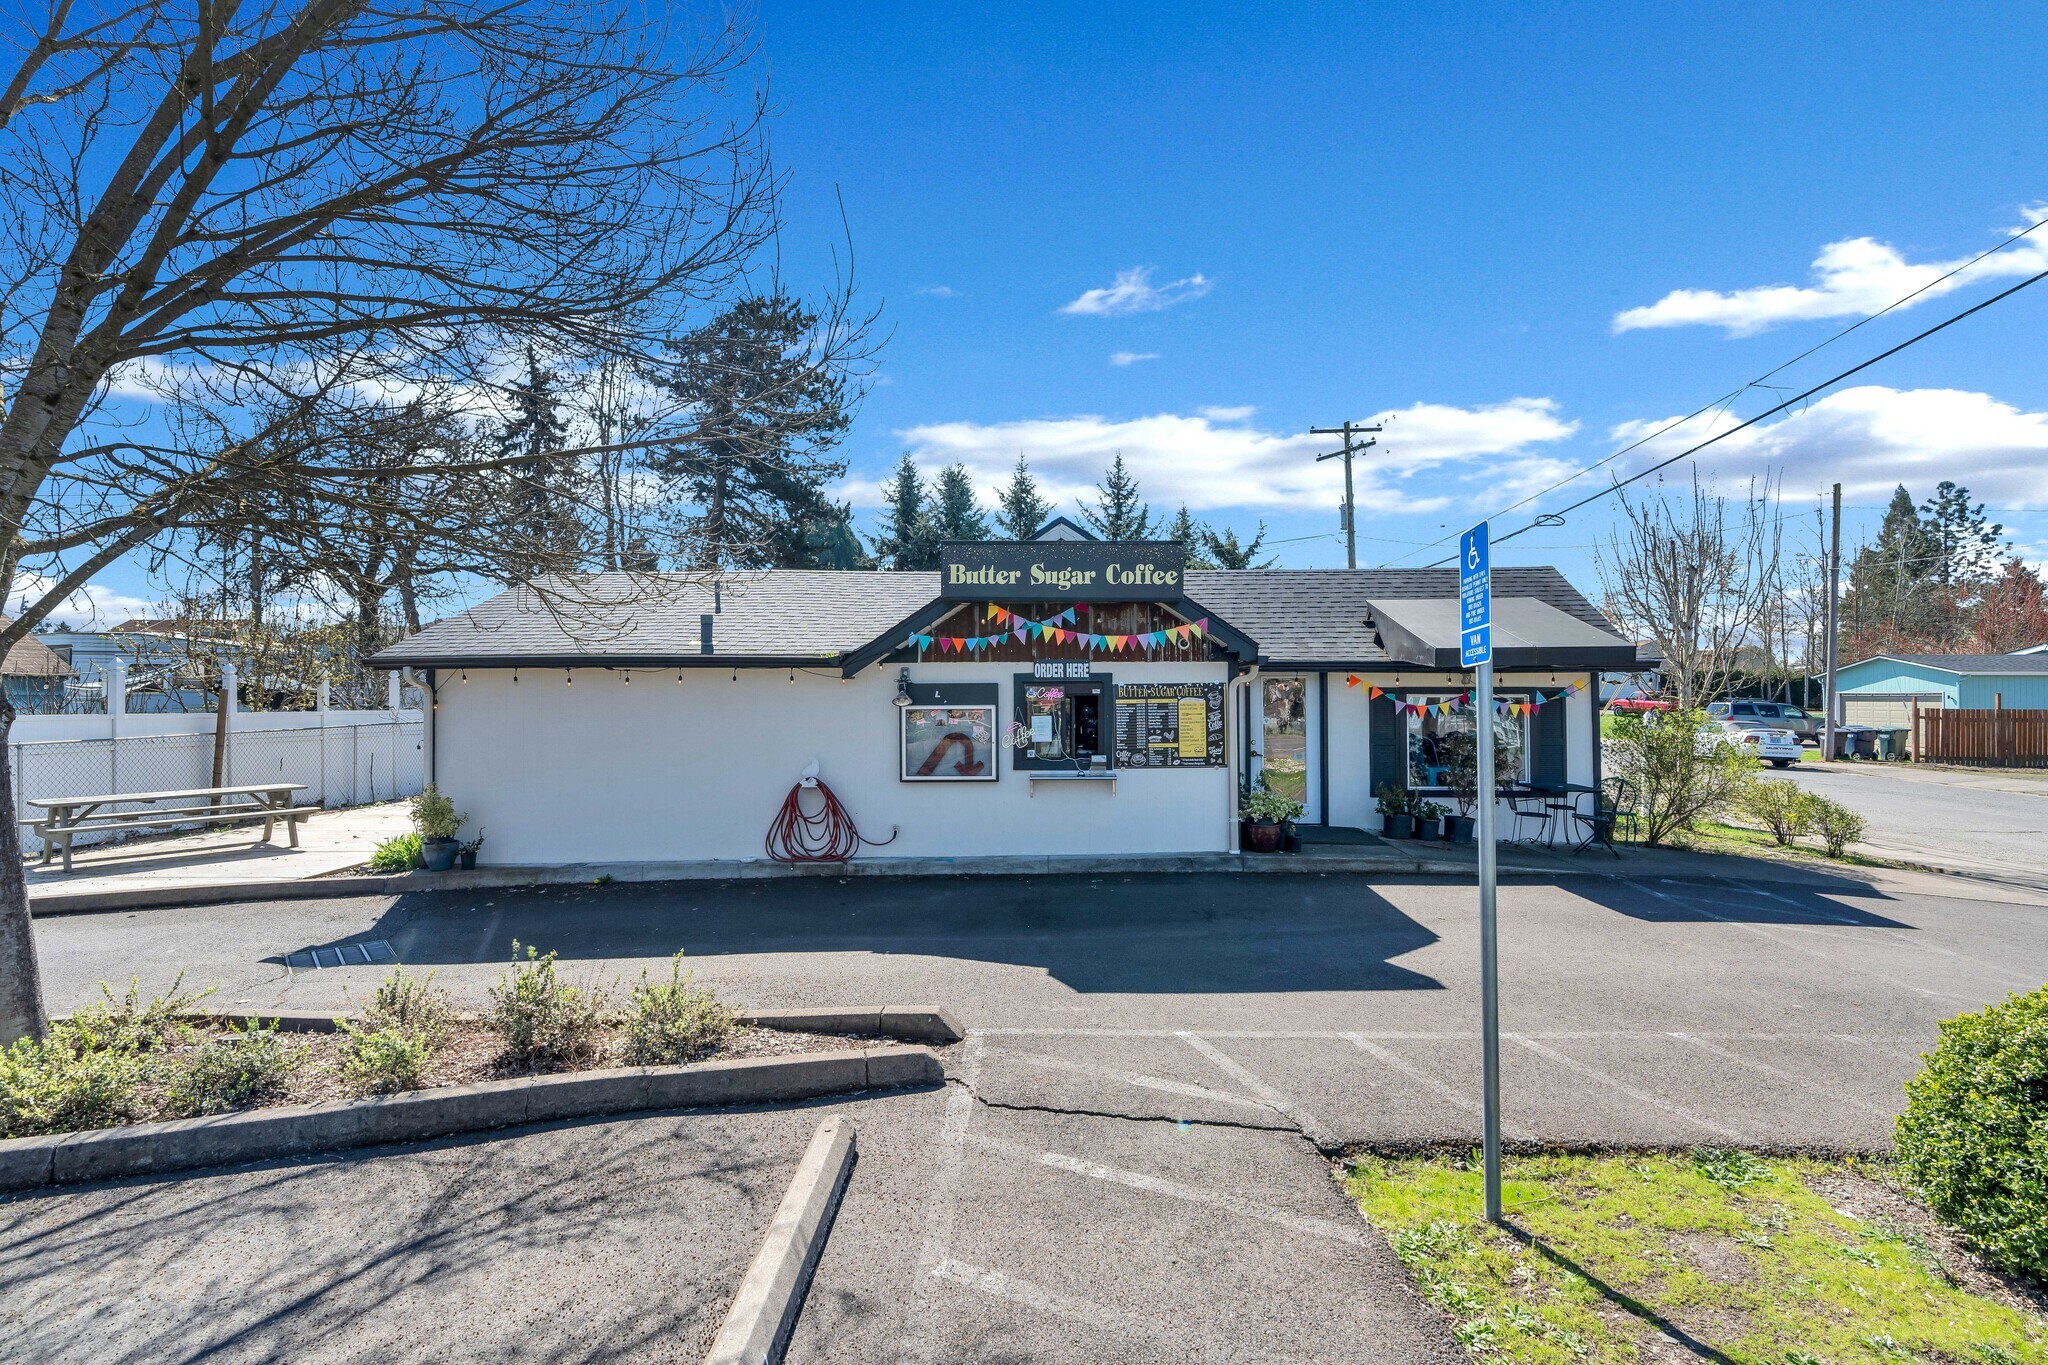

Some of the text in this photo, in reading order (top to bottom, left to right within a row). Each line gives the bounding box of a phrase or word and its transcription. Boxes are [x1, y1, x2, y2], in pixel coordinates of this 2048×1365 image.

[949, 562, 1179, 591] Butter Sugar Coffee
[1470, 633, 1481, 646] VAN
[1465, 645, 1487, 657] ACCESSIBLE
[1034, 663, 1090, 678] ORDER HERE
[934, 690, 941, 698] L
[1037, 687, 1064, 700] Coffee
[1118, 685, 1204, 698] BUTTER SUGAR COFFEE
[1001, 725, 1035, 749] Coffee
